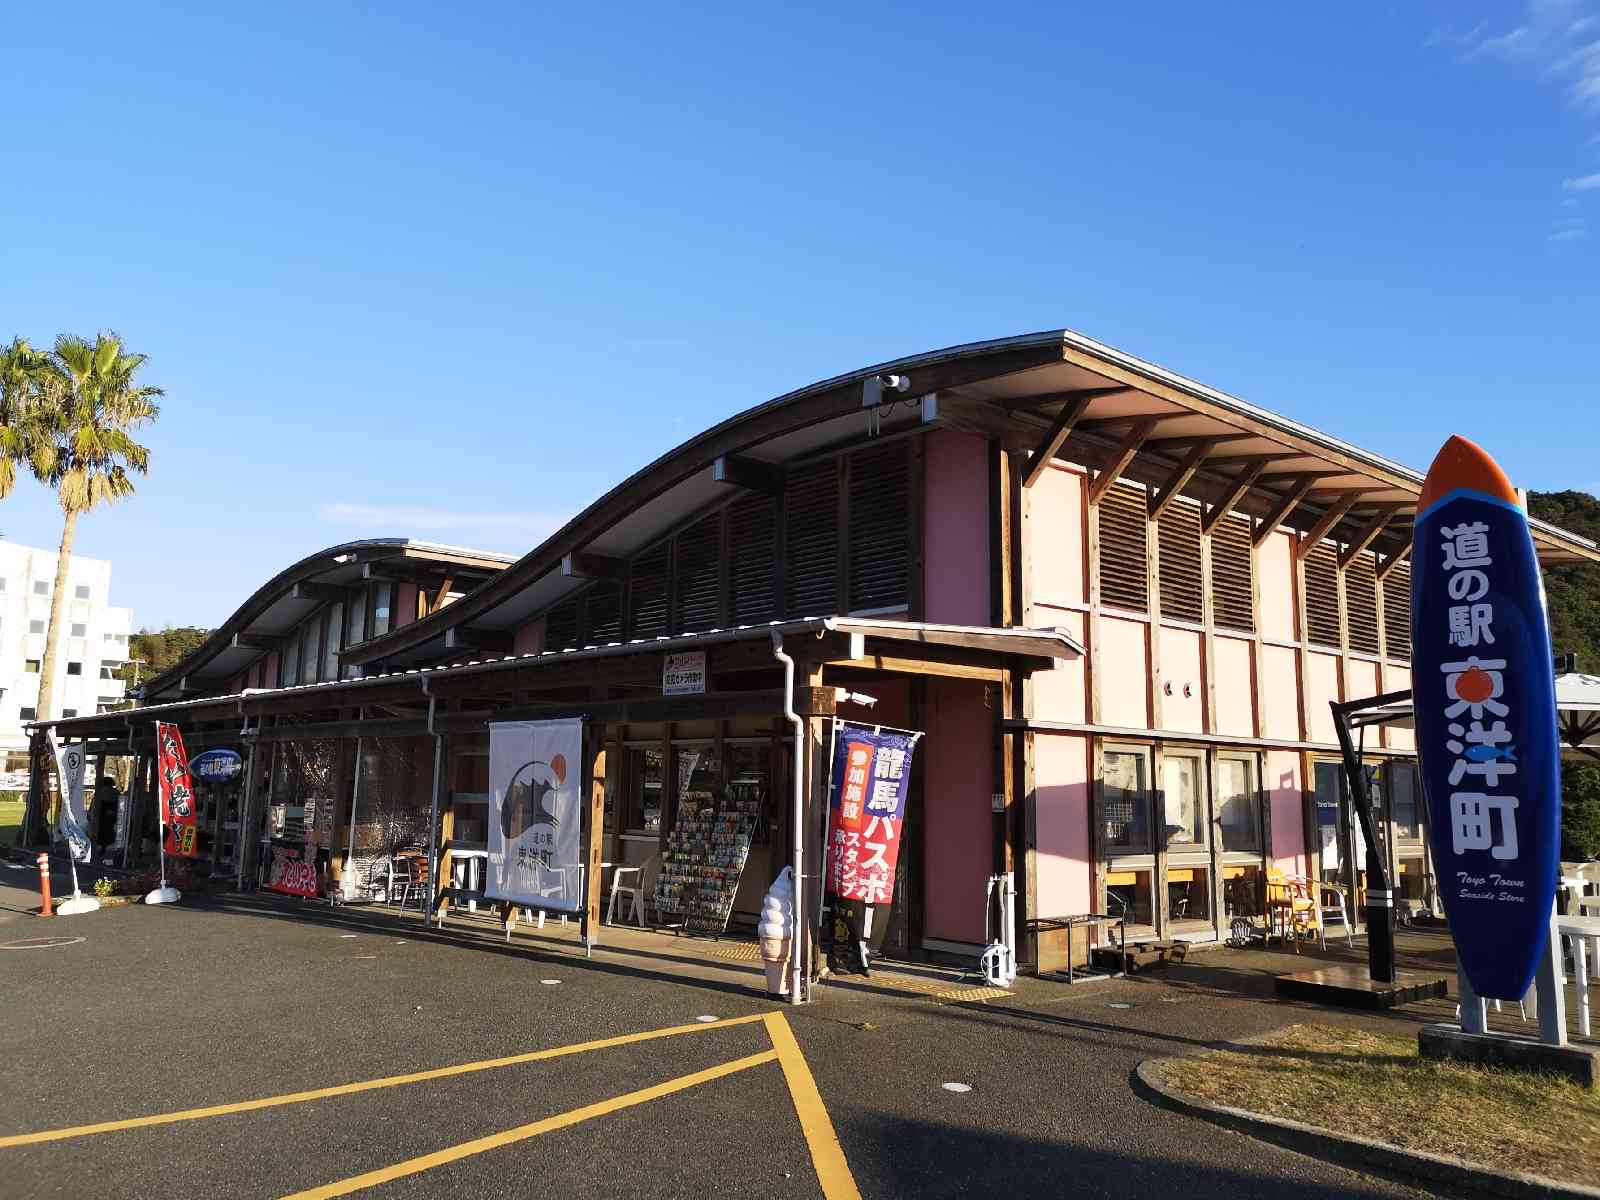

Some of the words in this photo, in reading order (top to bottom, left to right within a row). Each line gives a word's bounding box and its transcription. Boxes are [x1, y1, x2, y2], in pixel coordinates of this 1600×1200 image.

[1440, 521, 1496, 647] 道の駅
[843, 749, 868, 818] 参加施設
[1440, 656, 1521, 860] 東洋町
[842, 831, 861, 897] スタンプ
[1456, 871, 1487, 887] Toyo
[1489, 873, 1526, 888] Town
[1458, 888, 1496, 900] Seaside
[1498, 891, 1527, 903] Store
